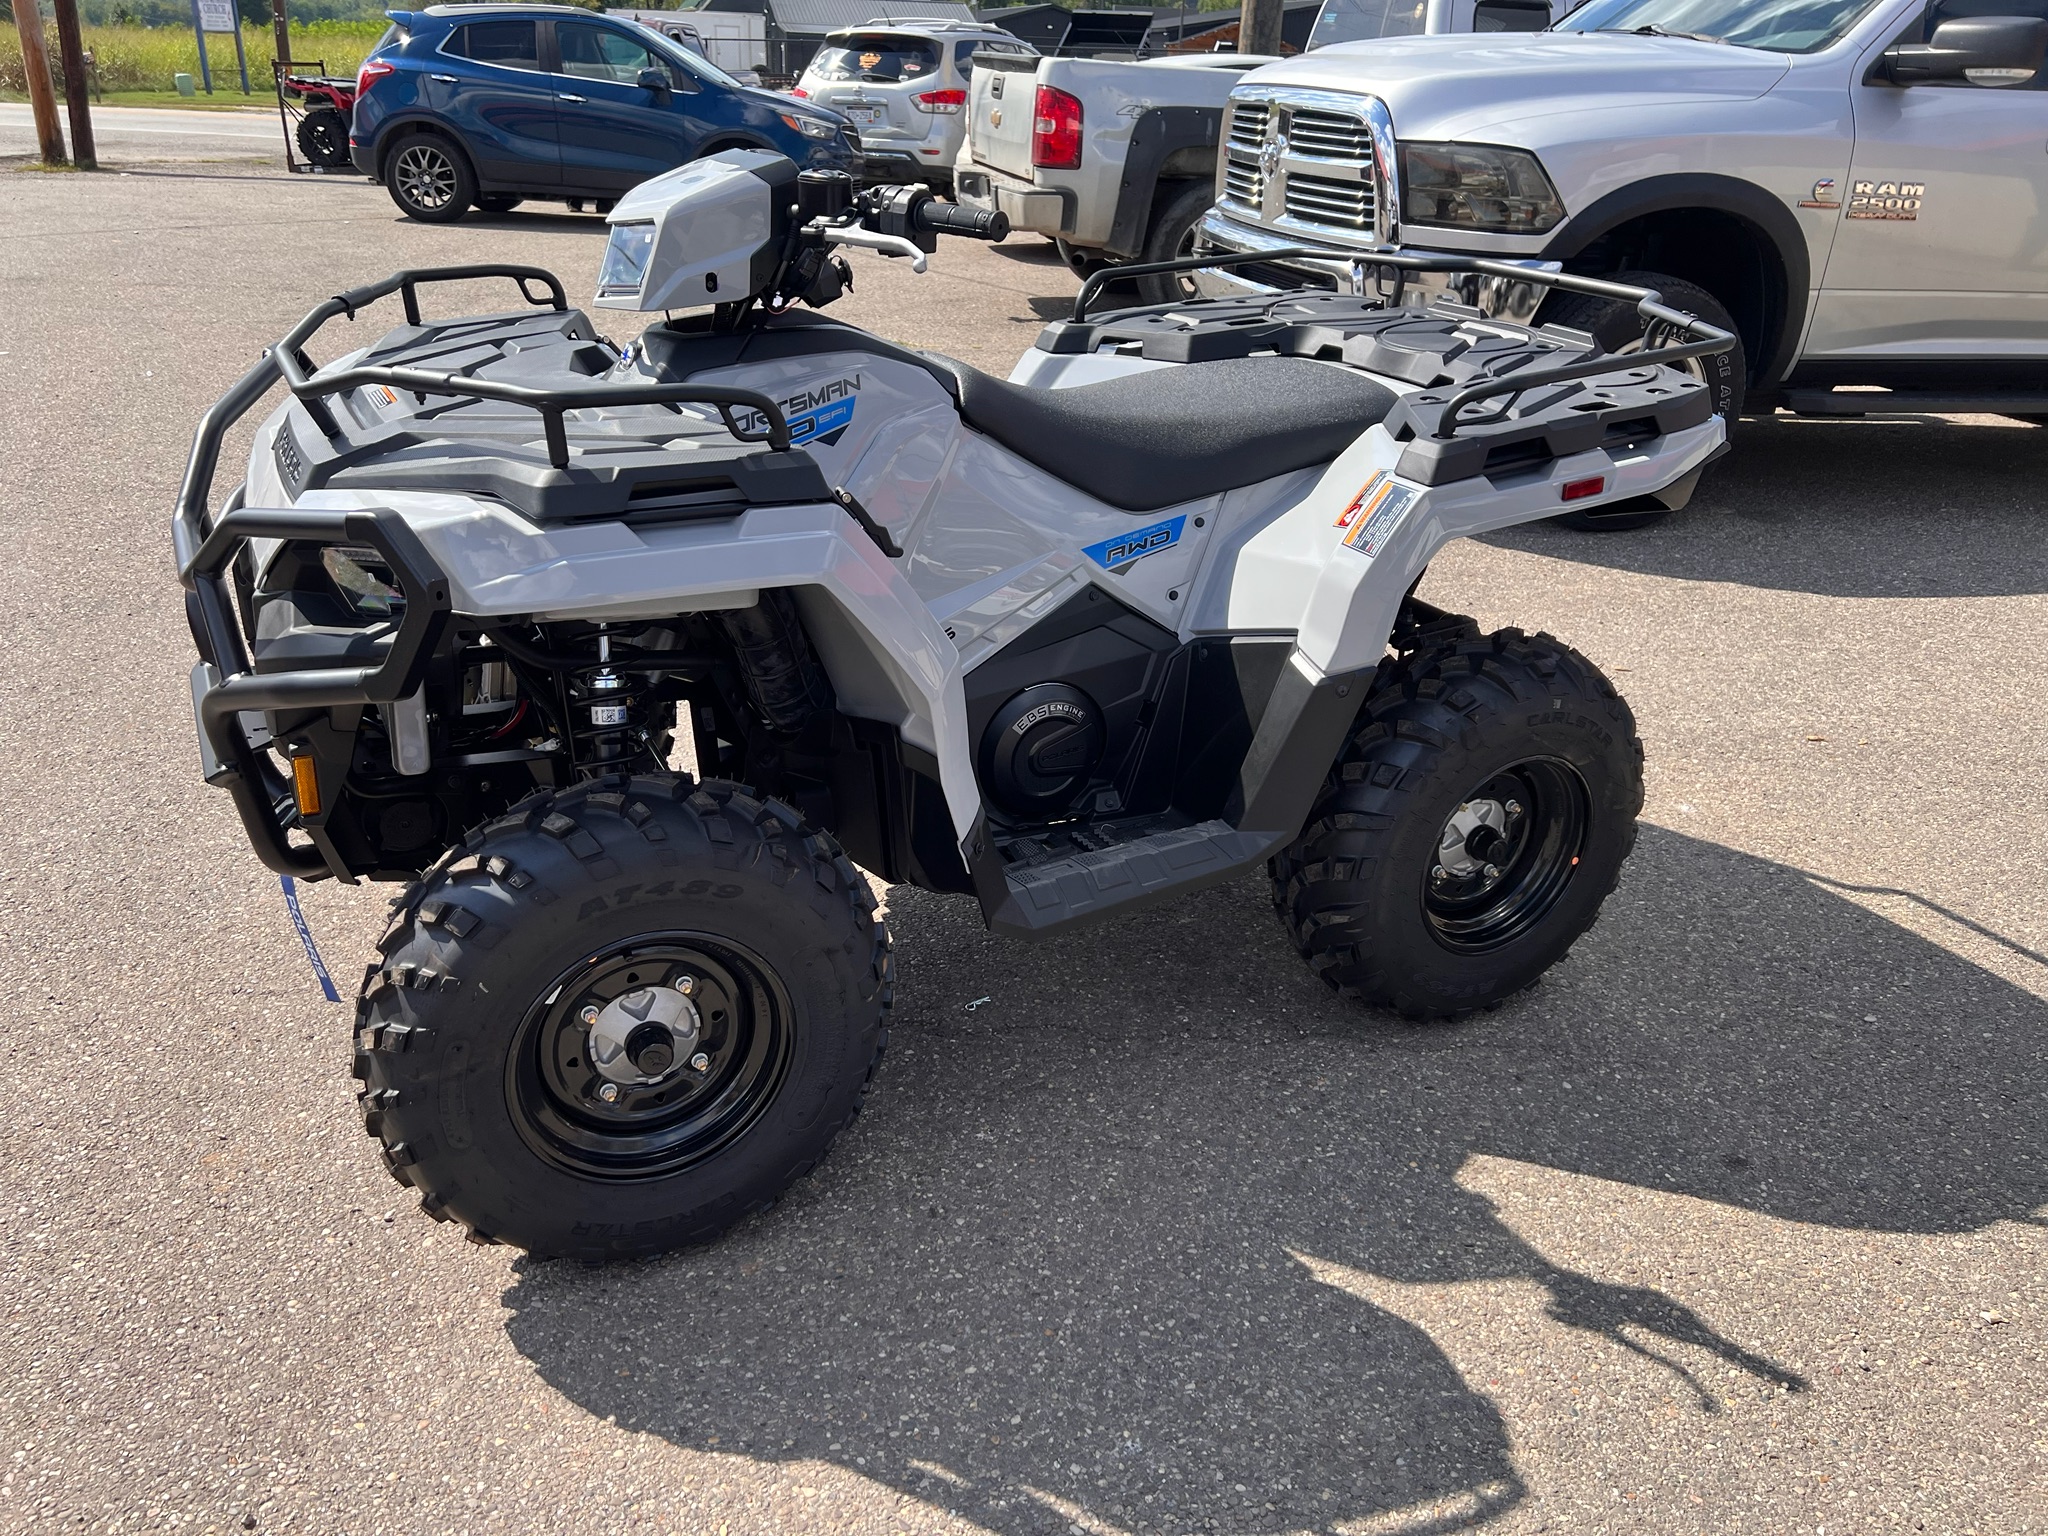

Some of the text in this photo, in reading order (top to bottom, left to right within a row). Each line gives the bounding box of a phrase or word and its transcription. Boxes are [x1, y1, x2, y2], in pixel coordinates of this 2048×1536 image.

[203, 4, 227, 14] CHURCH
[1853, 180, 1925, 196] RAM
[1849, 195, 1921, 211] 2500
[1720, 385, 1731, 410] AT
[818, 406, 847, 424] EFI
[1105, 522, 1171, 548] ON DEMAND
[1106, 529, 1171, 563] AWD
[1016, 706, 1047, 731] EBS
[1050, 704, 1084, 718] ENGINE
[286, 894, 328, 978] POLARIS
